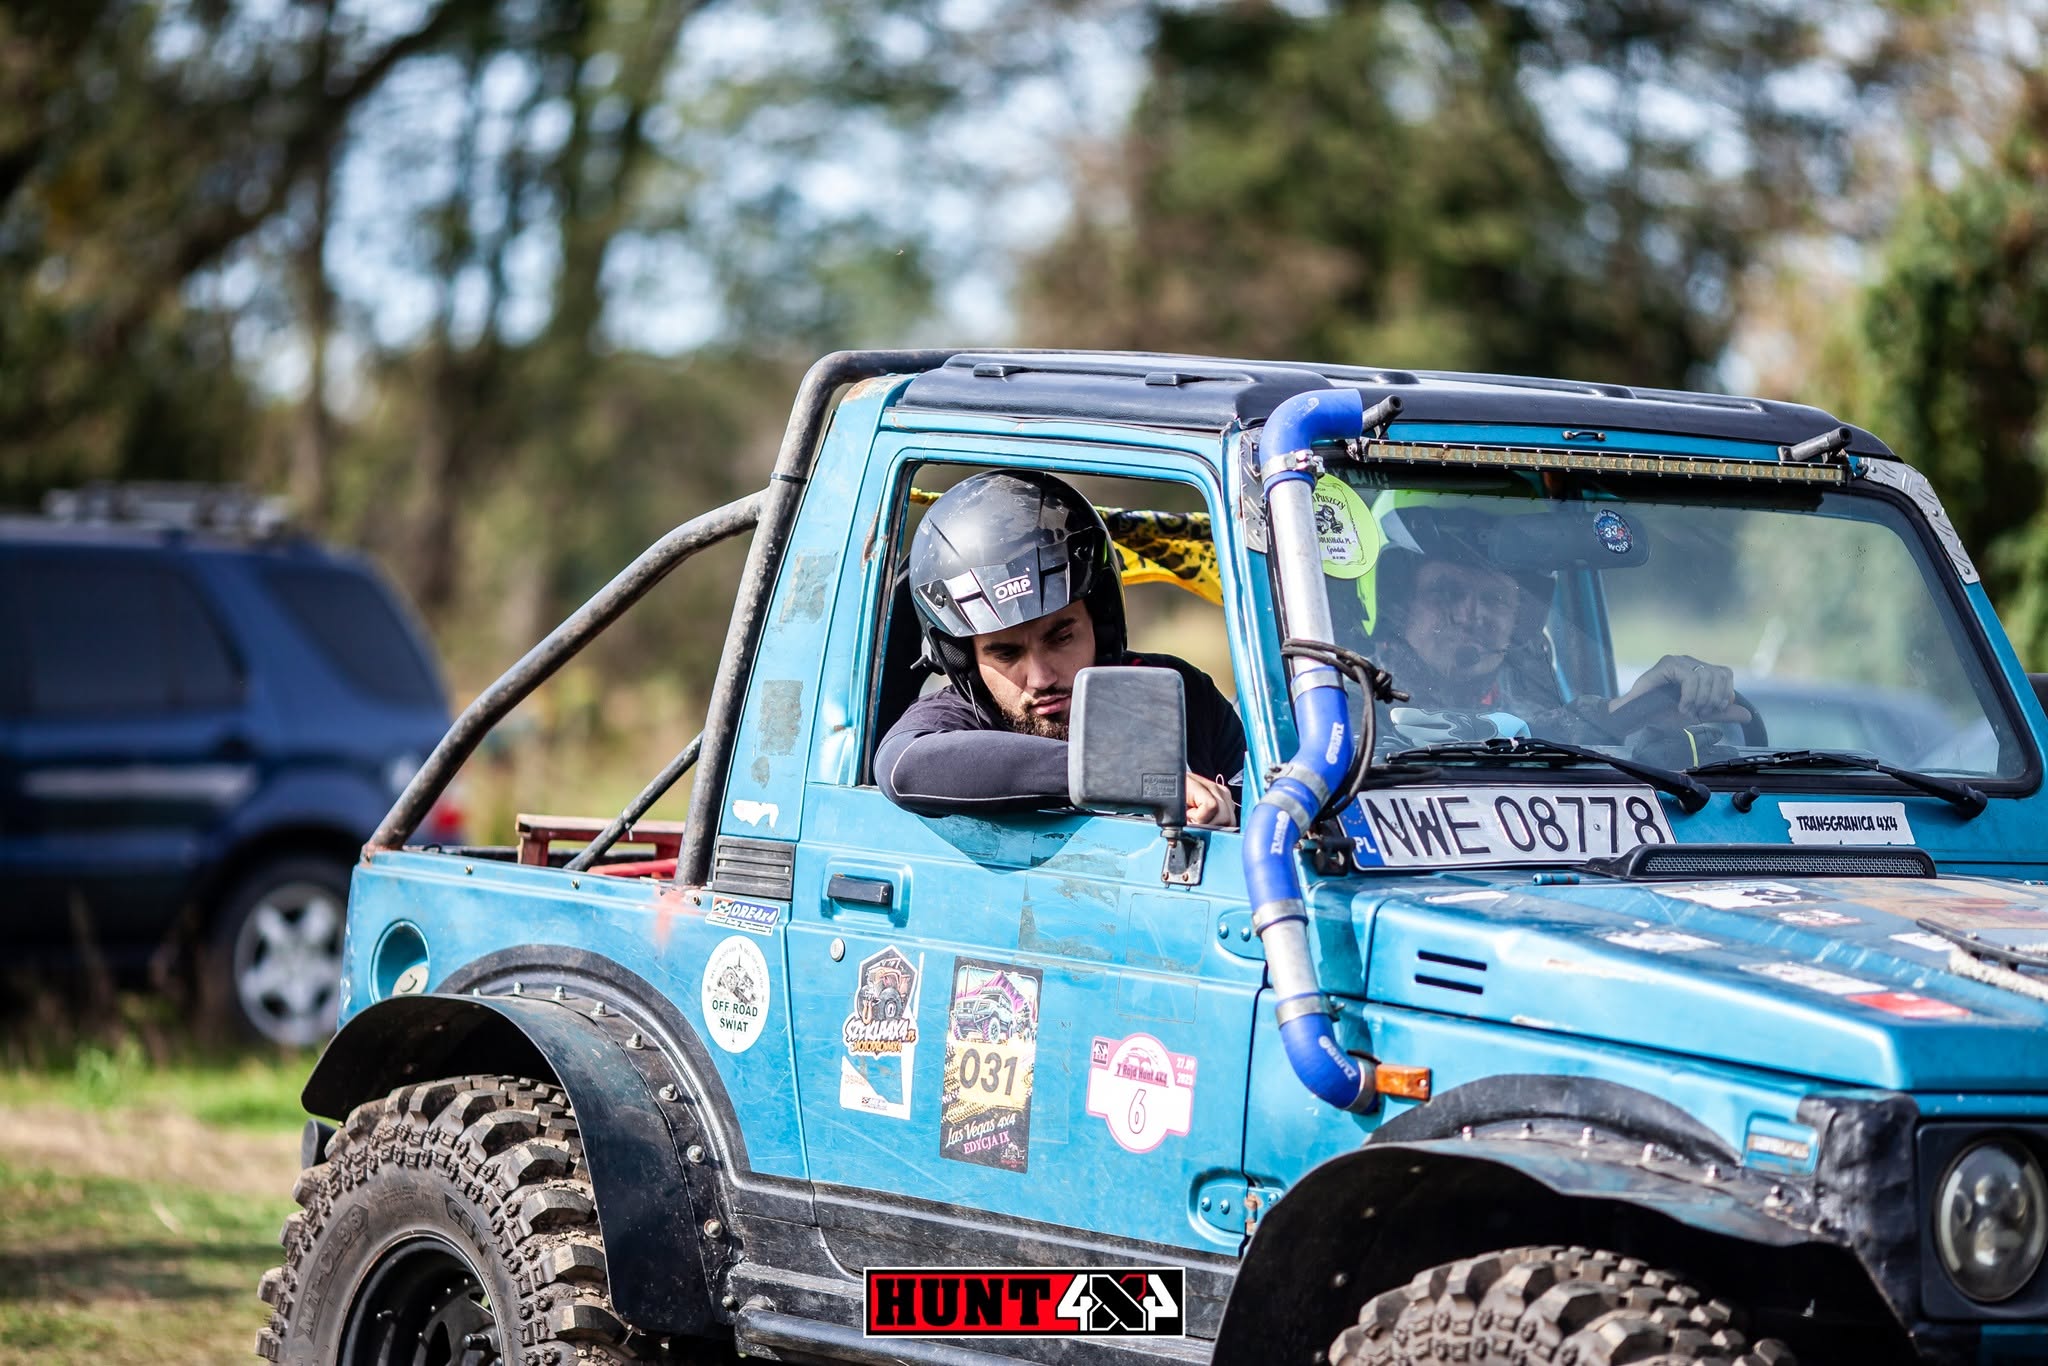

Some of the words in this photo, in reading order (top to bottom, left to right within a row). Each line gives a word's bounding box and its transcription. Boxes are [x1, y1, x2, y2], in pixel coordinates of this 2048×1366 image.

[1604, 525, 1618, 538] 33
[995, 578, 1031, 599] OMP
[1365, 796, 1491, 857] NWE
[1494, 796, 1667, 854] 08778
[1796, 816, 1875, 832] TRANSGRANICA
[1876, 816, 1898, 831] 4X4
[1354, 836, 1377, 854] PL
[712, 999, 730, 1013] OFF
[732, 1003, 758, 1017] ROAD
[960, 1048, 1018, 1096] 031
[1122, 1065, 1137, 1080] Rajd
[1128, 1088, 1146, 1134] 6
[945, 1127, 964, 1148] Las
[964, 1117, 995, 1140] Vegas
[963, 1134, 999, 1154] EDYCJA
[999, 1131, 1011, 1145] IX
